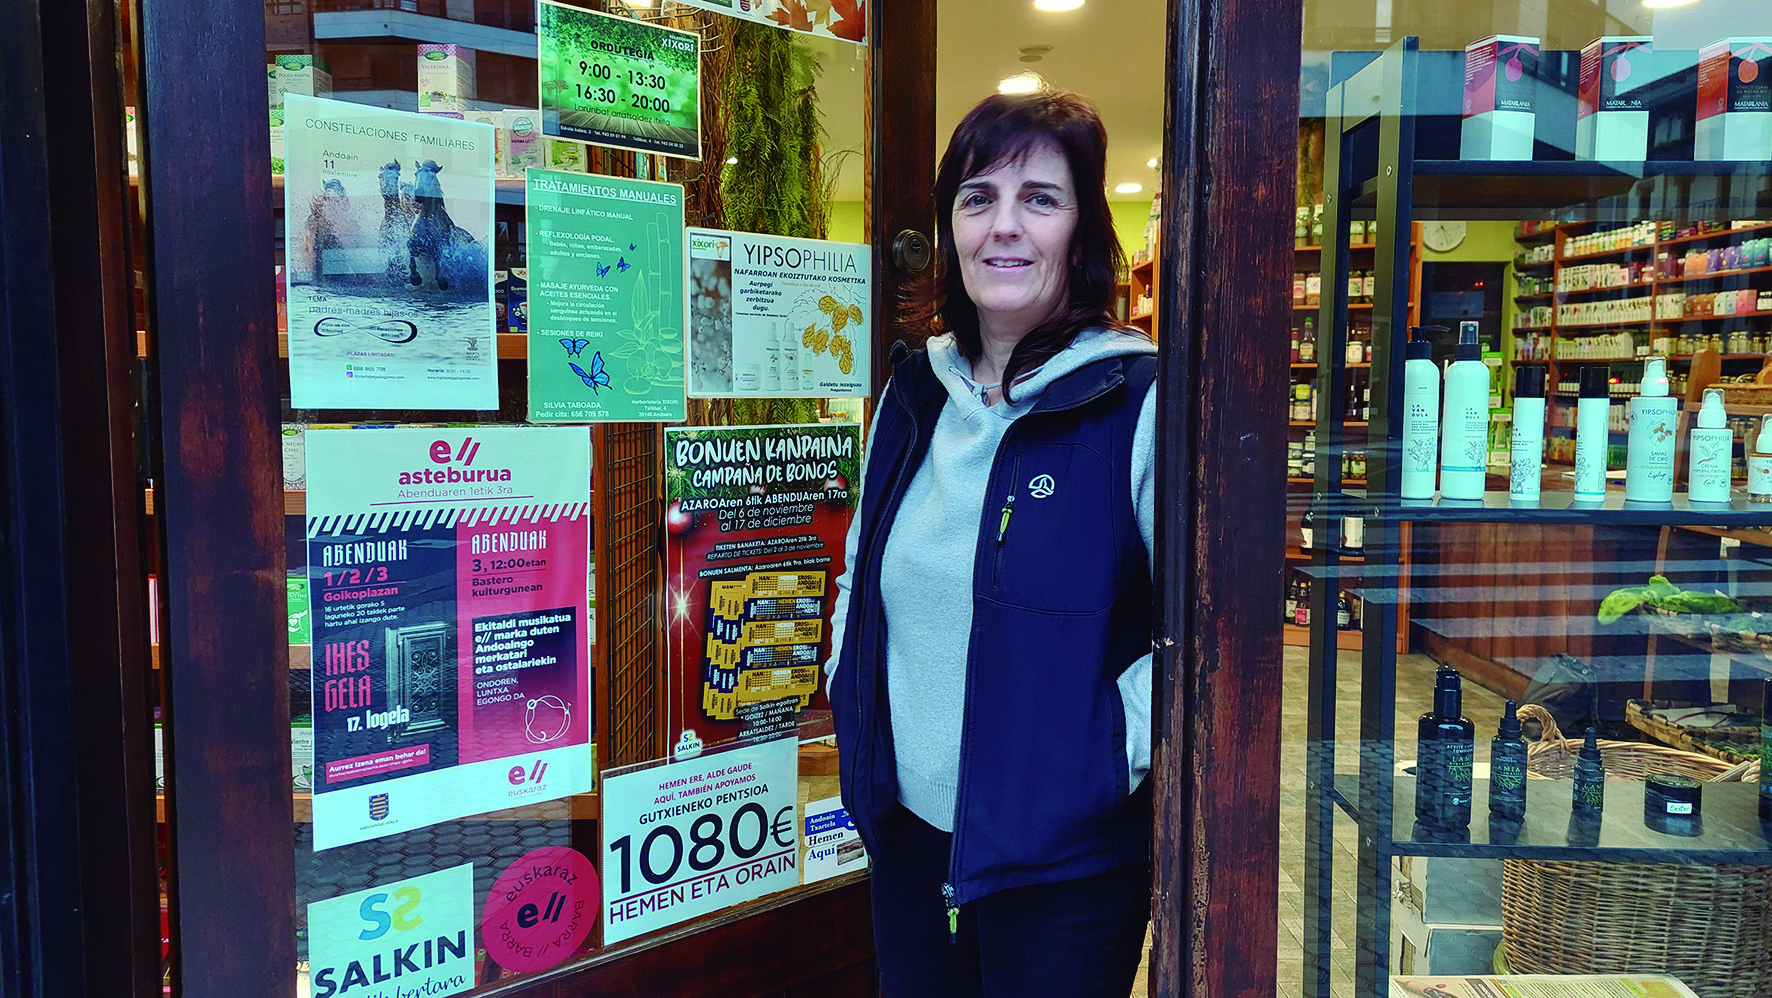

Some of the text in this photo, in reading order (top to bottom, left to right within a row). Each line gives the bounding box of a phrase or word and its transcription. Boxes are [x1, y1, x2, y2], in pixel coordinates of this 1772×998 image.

[591, 40, 654, 60] ORDUTEGIA
[661, 38, 693, 52] XIXORI
[579, 61, 665, 90] 9:00 13:30
[576, 84, 670, 112] 16:30 20:00
[574, 103, 609, 115] Larunbat
[651, 117, 670, 126] itxita
[305, 118, 475, 151] CONSTELACIONES FAMILIARES
[322, 150, 358, 160] Andoain
[324, 160, 335, 169] 11
[322, 170, 357, 178] noviembre
[533, 179, 676, 204] TRATAMIENTOS MANUALES
[539, 205, 633, 220] DRENAJE LINFÁTICO MANUAL
[540, 231, 615, 243] REFLEXOLOGÍA PODAL.
[692, 238, 714, 248] xixori
[743, 243, 857, 273] YIPSOPHILIA
[734, 268, 866, 284] NAFARROAN EKOIZTUTAKO KOSMETIKA
[749, 280, 773, 288] Aurpegi
[540, 282, 567, 290] MASAJE
[569, 283, 603, 292] AYURVEDA
[740, 288, 782, 296] garbiketarako
[570, 292, 611, 300] ESENCIALES.
[675, 433, 853, 466] BONUEN KANPAINA
[398, 467, 512, 485] asteburua
[692, 460, 838, 488] CAMPAÑA DE BONOS
[397, 485, 513, 499] Abenduaren 1etik 3ra
[681, 489, 848, 511] AZAROAren 6tik ABENDUAren 17ra
[719, 503, 814, 520] Del 6 de noviembre
[721, 514, 812, 531] al 17 de diciembre
[472, 530, 546, 554] ABENDUAK
[323, 539, 407, 566] ABENDUAK
[472, 576, 513, 586] Bastero
[323, 587, 399, 601] Goikoplazan
[472, 584, 542, 597] kulturgunean
[325, 612, 355, 620] laguneko
[388, 606, 405, 614] parte
[333, 604, 355, 612] urtetik
[356, 602, 379, 610] gorako
[359, 616, 381, 624] izango
[475, 614, 571, 632] Ekitaldi musikatua
[494, 628, 527, 640] marka
[530, 625, 559, 636] duten
[475, 639, 534, 653] Andoaingo
[325, 640, 370, 676] IHES
[475, 649, 527, 664] merkatari
[475, 656, 556, 674] eta ostalariekin
[325, 675, 371, 712] GELA
[477, 687, 509, 697] LUNTXA
[477, 694, 512, 706] EGONGO
[347, 705, 409, 732] 17. logela
[677, 741, 700, 752] SALKIN
[329, 763, 353, 772] Aurrez
[375, 756, 393, 764] eman
[395, 751, 414, 760] behar
[658, 762, 752, 791] HEMEN ERE, ALDE GAUDE
[508, 785, 546, 797] euskaraz
[653, 773, 756, 805] AQUÍ, TAMBIÉN APOYAMOS
[639, 783, 769, 825] GUTXIENEKO PENTSIOA
[810, 813, 835, 824] Andoain
[810, 821, 836, 831] Txartela
[809, 832, 844, 846] Hemen
[609, 802, 795, 894] 1080€
[808, 844, 835, 860] Aquí
[506, 864, 578, 902] euskaraz
[610, 853, 796, 925] HEMEN ETA ORAIN
[552, 900, 584, 948] BARRA
[500, 920, 532, 958] BARRA
[314, 929, 466, 998] SALKIN
